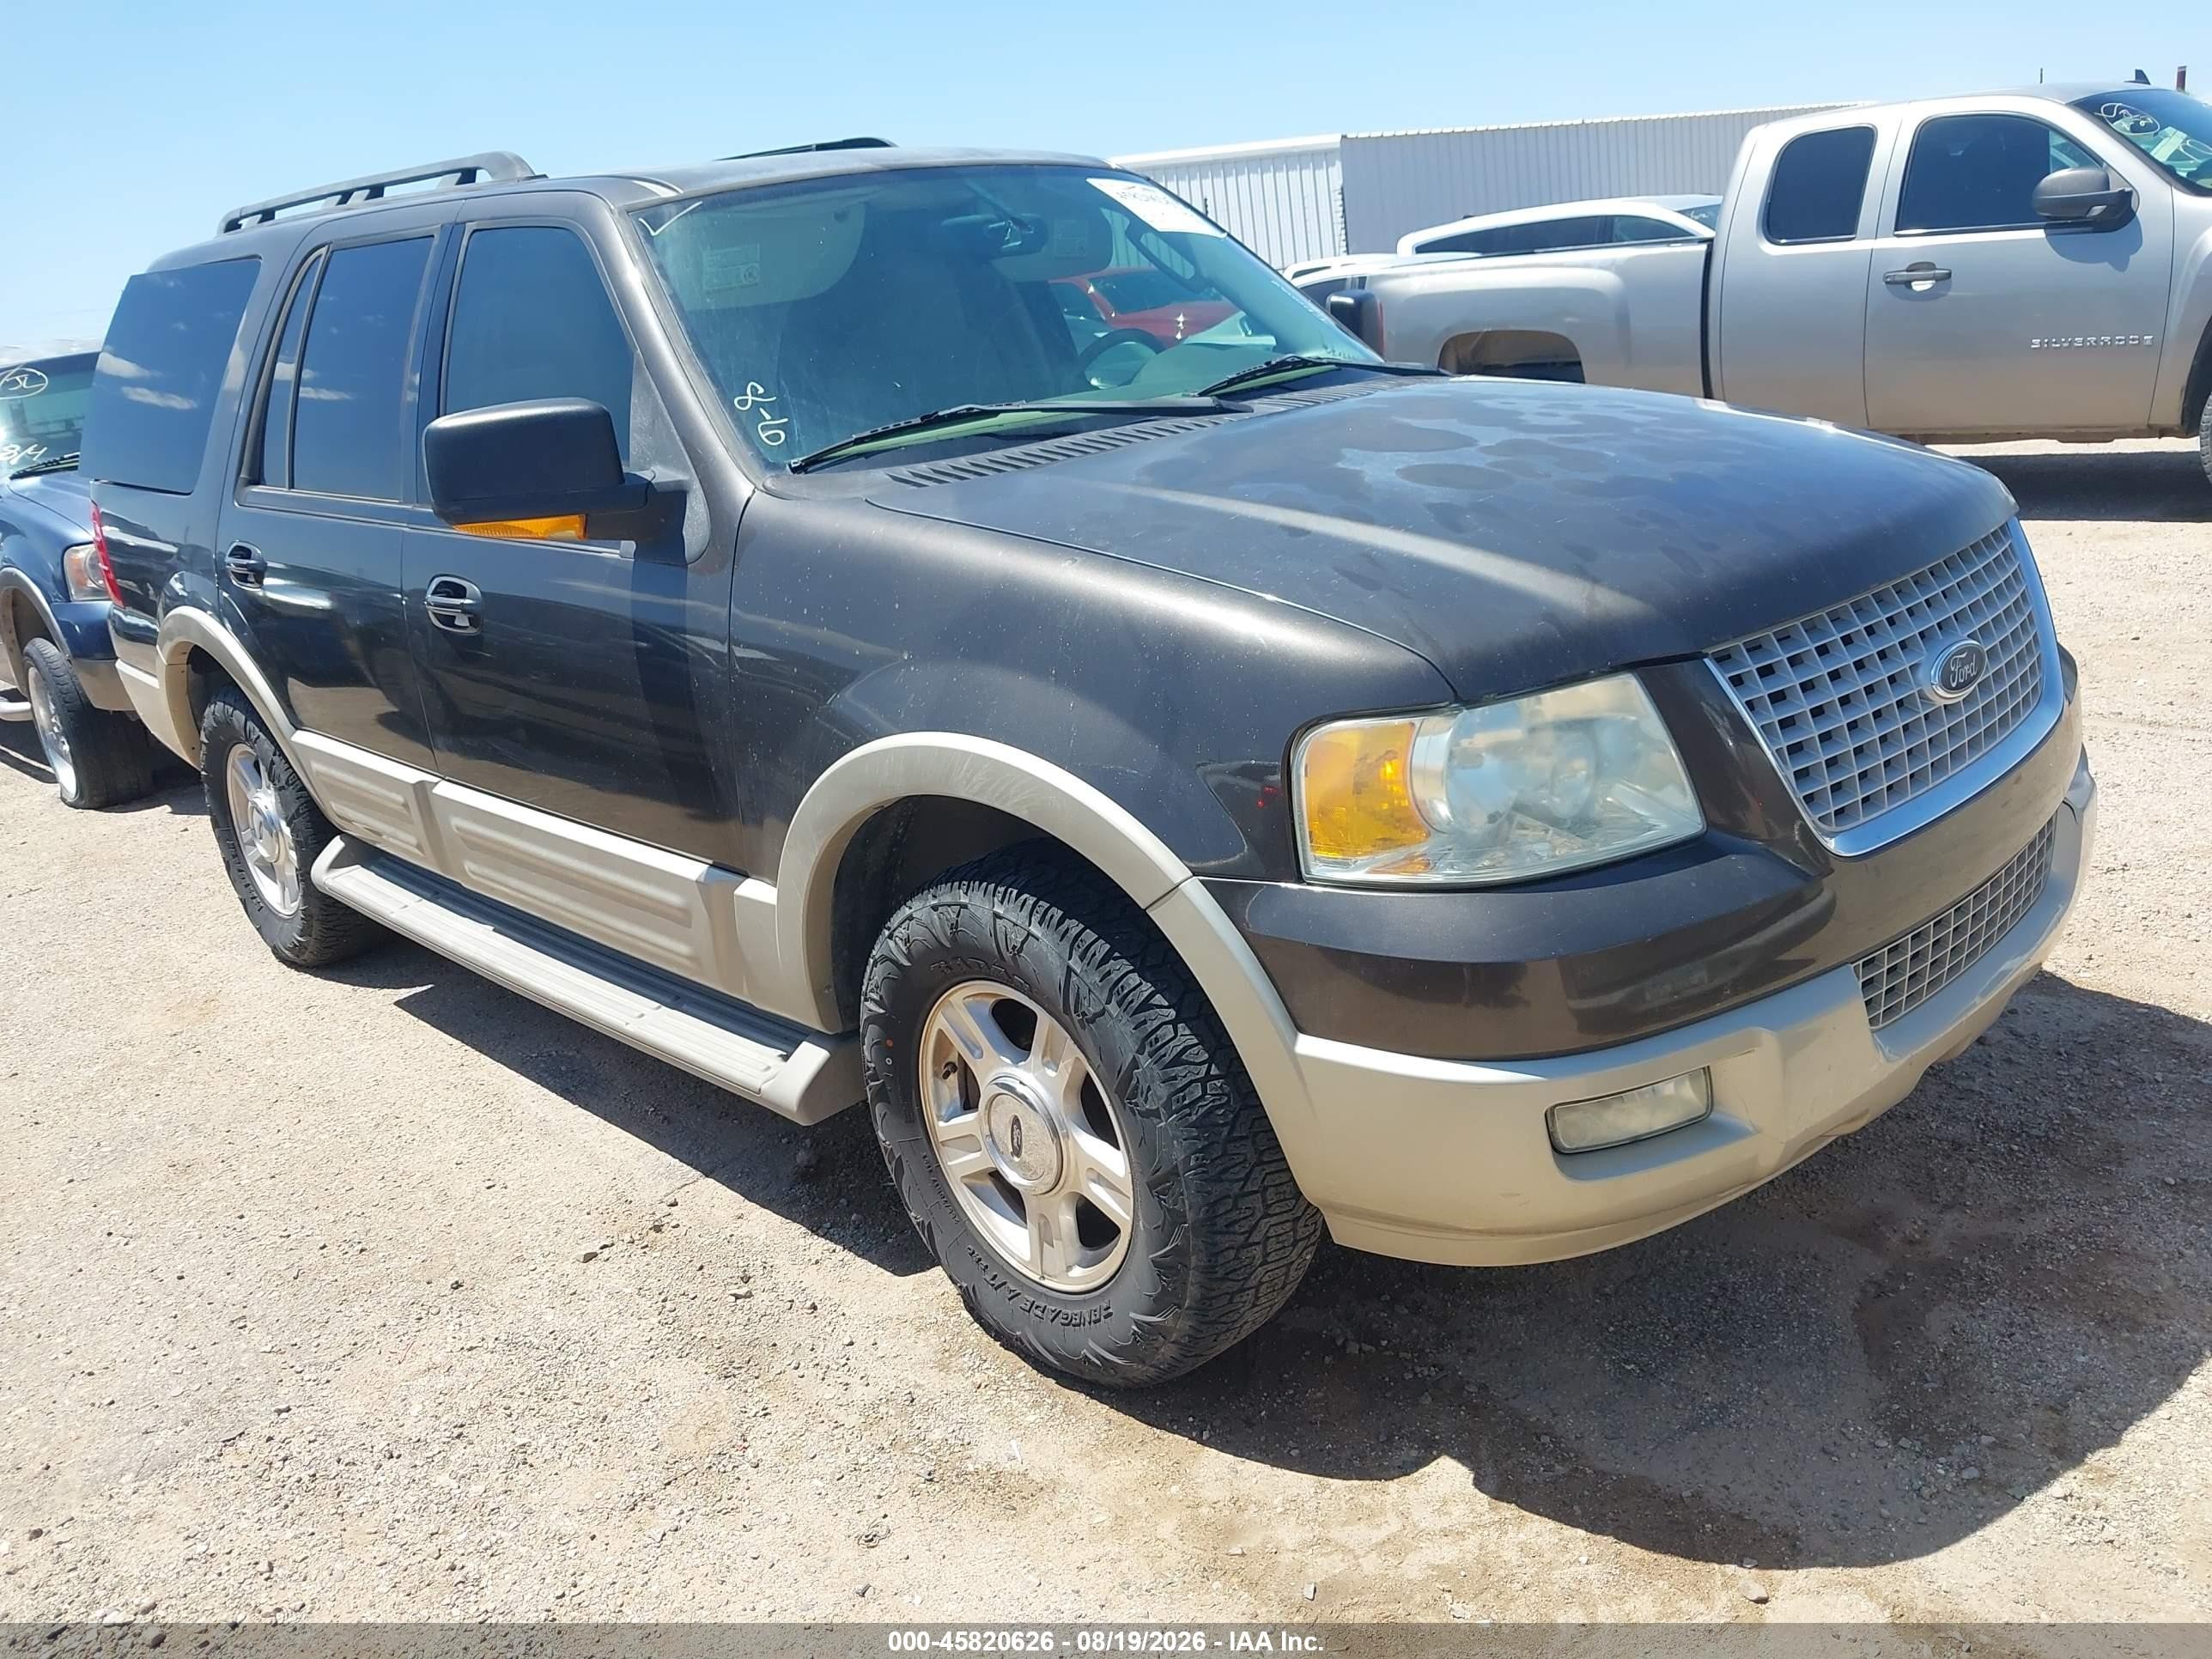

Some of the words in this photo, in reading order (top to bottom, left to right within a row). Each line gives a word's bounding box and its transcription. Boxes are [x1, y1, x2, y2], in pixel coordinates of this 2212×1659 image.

[2030, 335, 2139, 348] SILVERADO
[1950, 651, 1978, 688] Ford
[1020, 1295, 1114, 1328] RENEGADE
